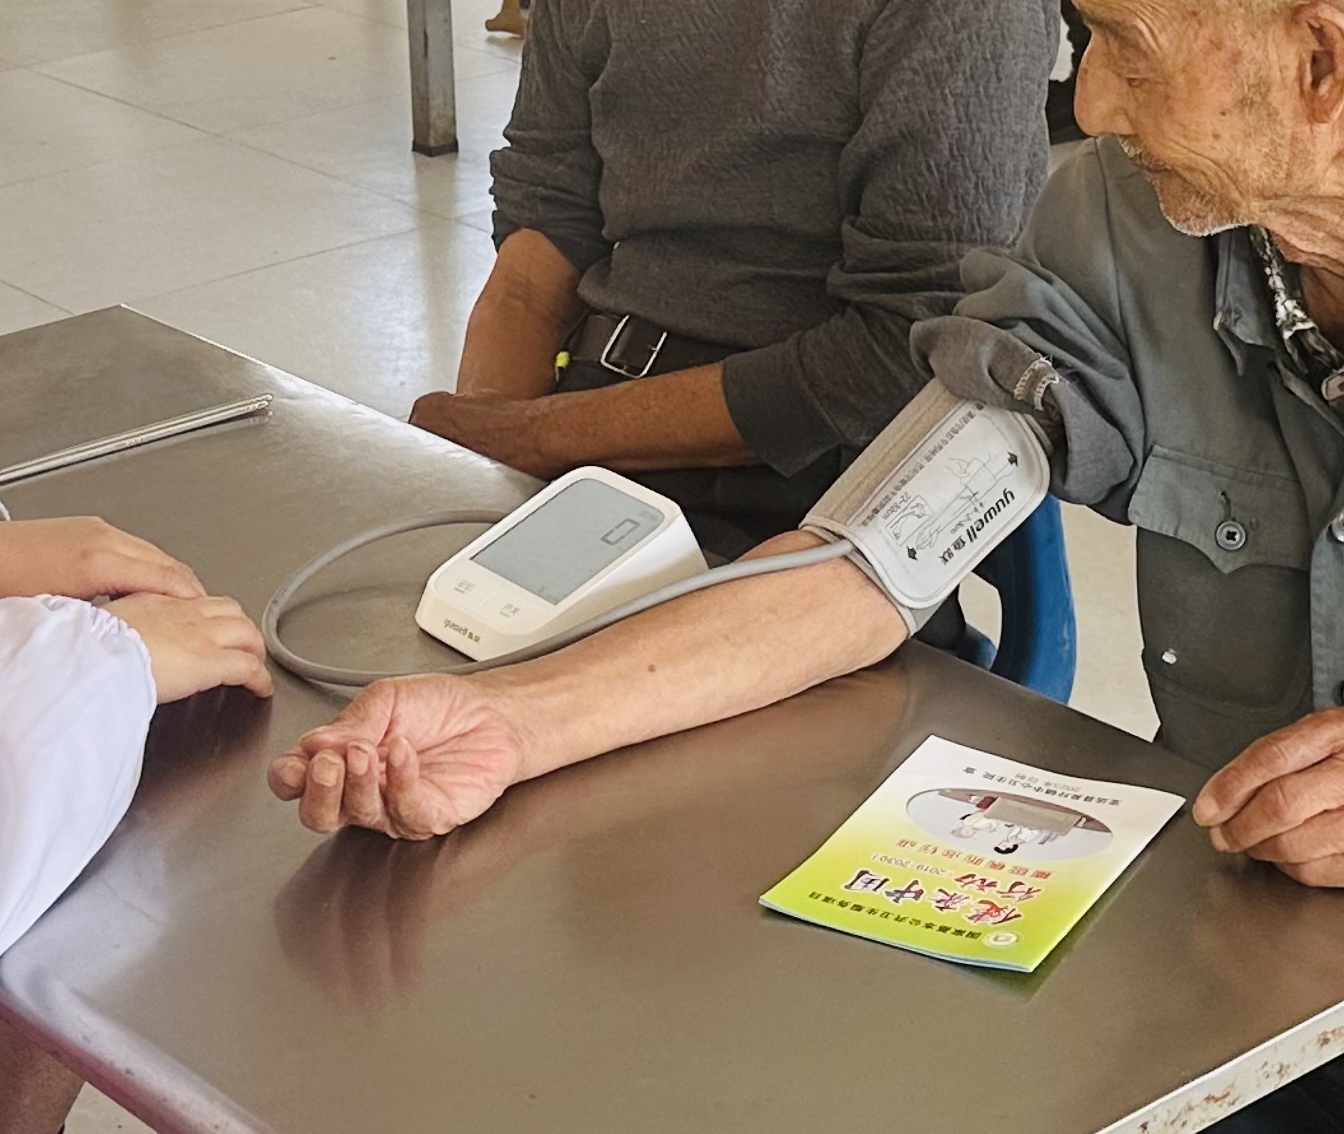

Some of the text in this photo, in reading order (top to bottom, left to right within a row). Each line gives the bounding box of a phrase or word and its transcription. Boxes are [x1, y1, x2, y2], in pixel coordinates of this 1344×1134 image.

[966, 487, 1015, 543] yuwell
[939, 534, 967, 565] 鱼跃
[844, 869, 1023, 926] 健康中国
